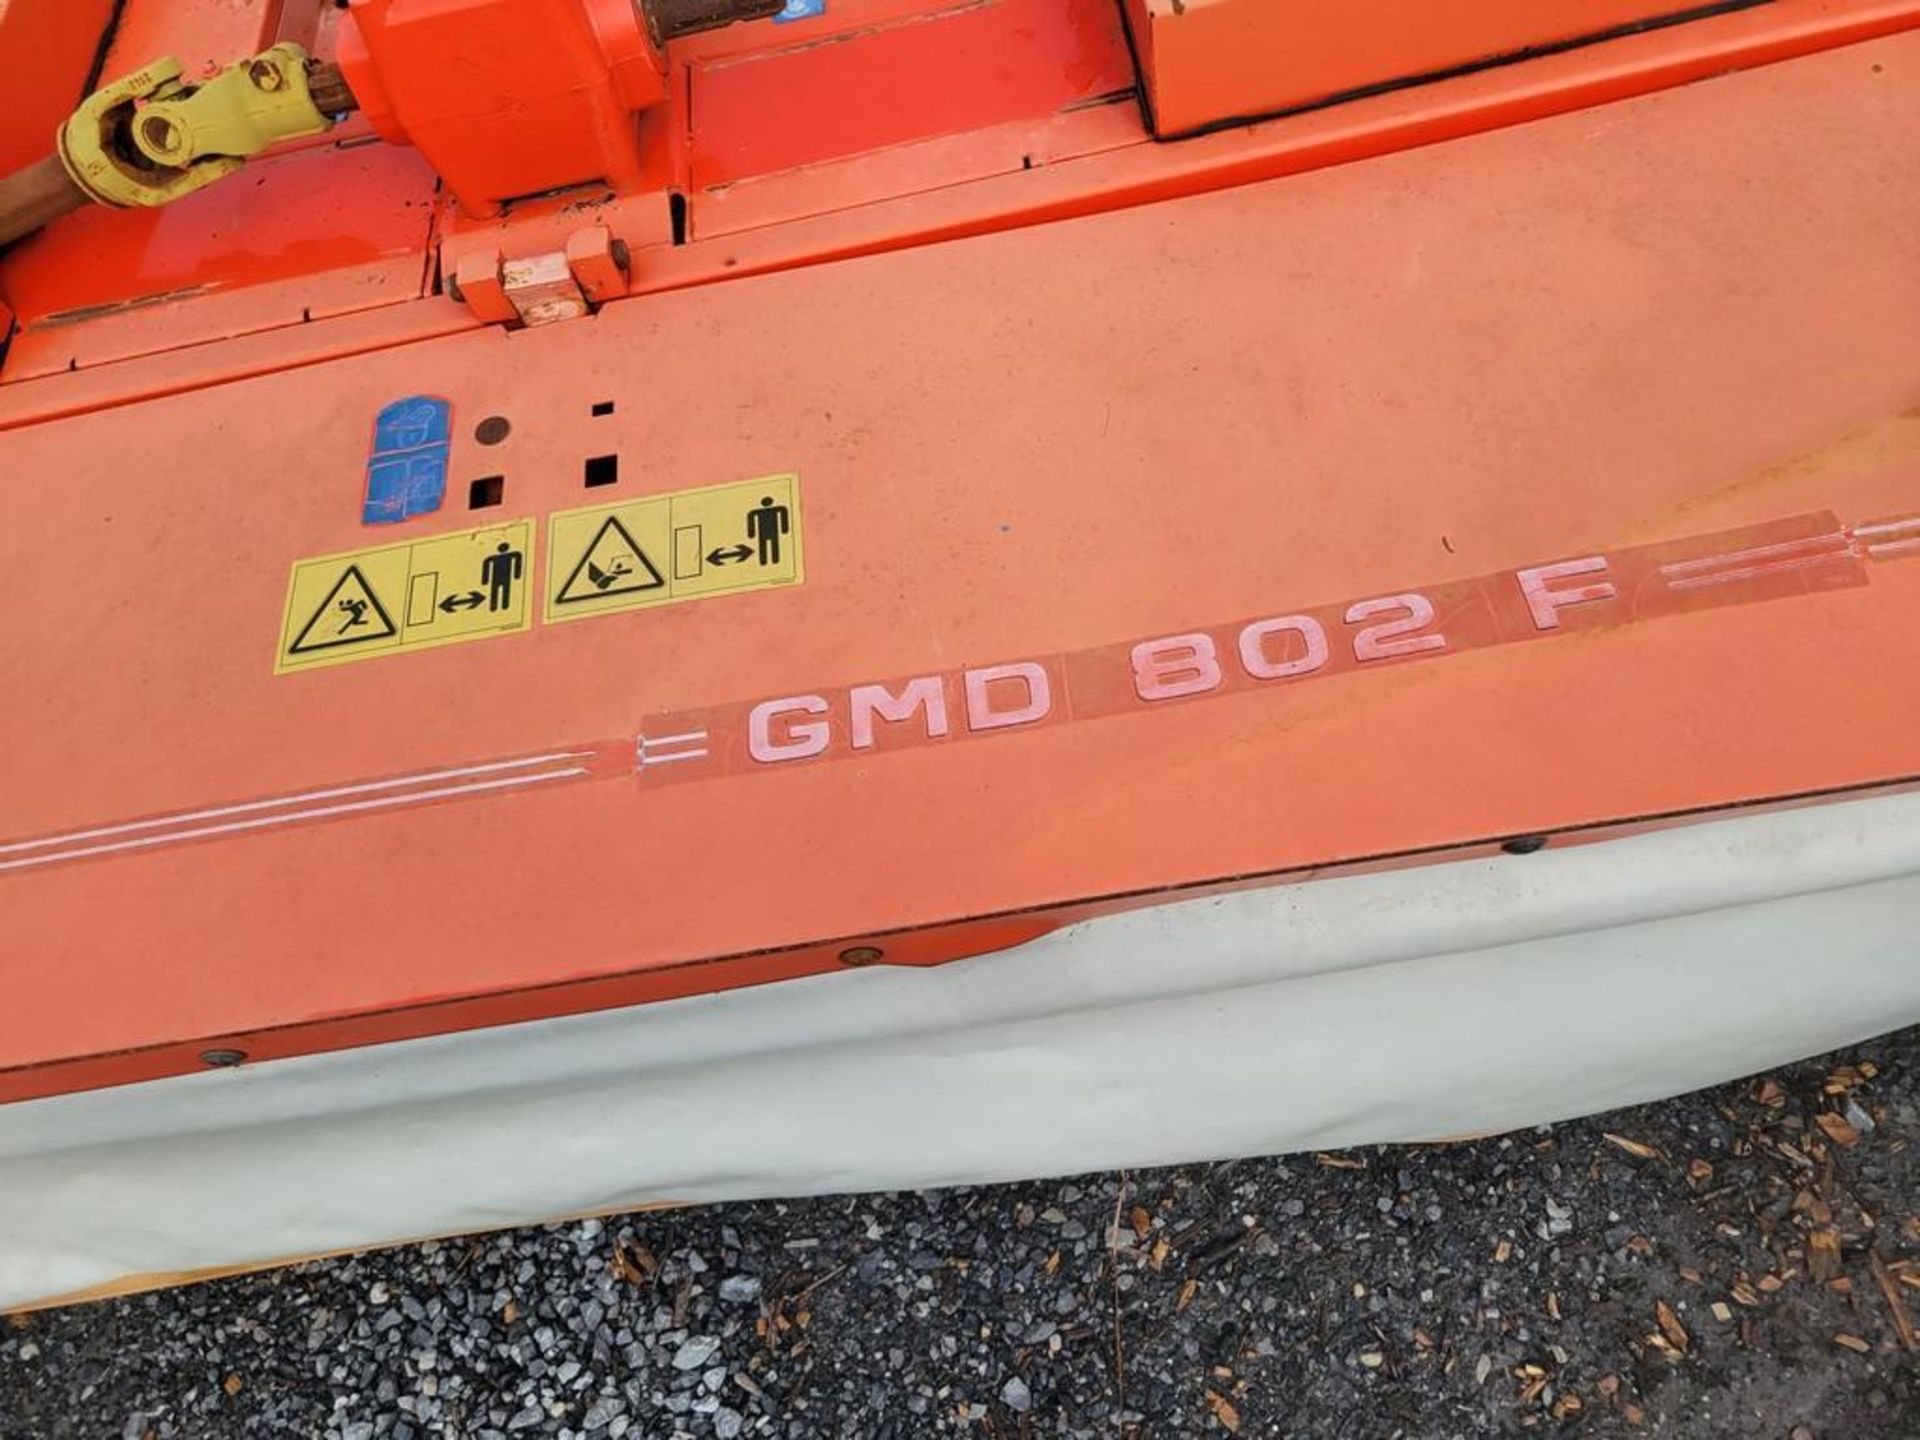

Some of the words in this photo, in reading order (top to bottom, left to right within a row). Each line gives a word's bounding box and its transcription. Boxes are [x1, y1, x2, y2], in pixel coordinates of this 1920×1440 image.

[748, 661, 1051, 762] GMD
[1130, 593, 1446, 701] 802
[1516, 556, 1616, 630] F
